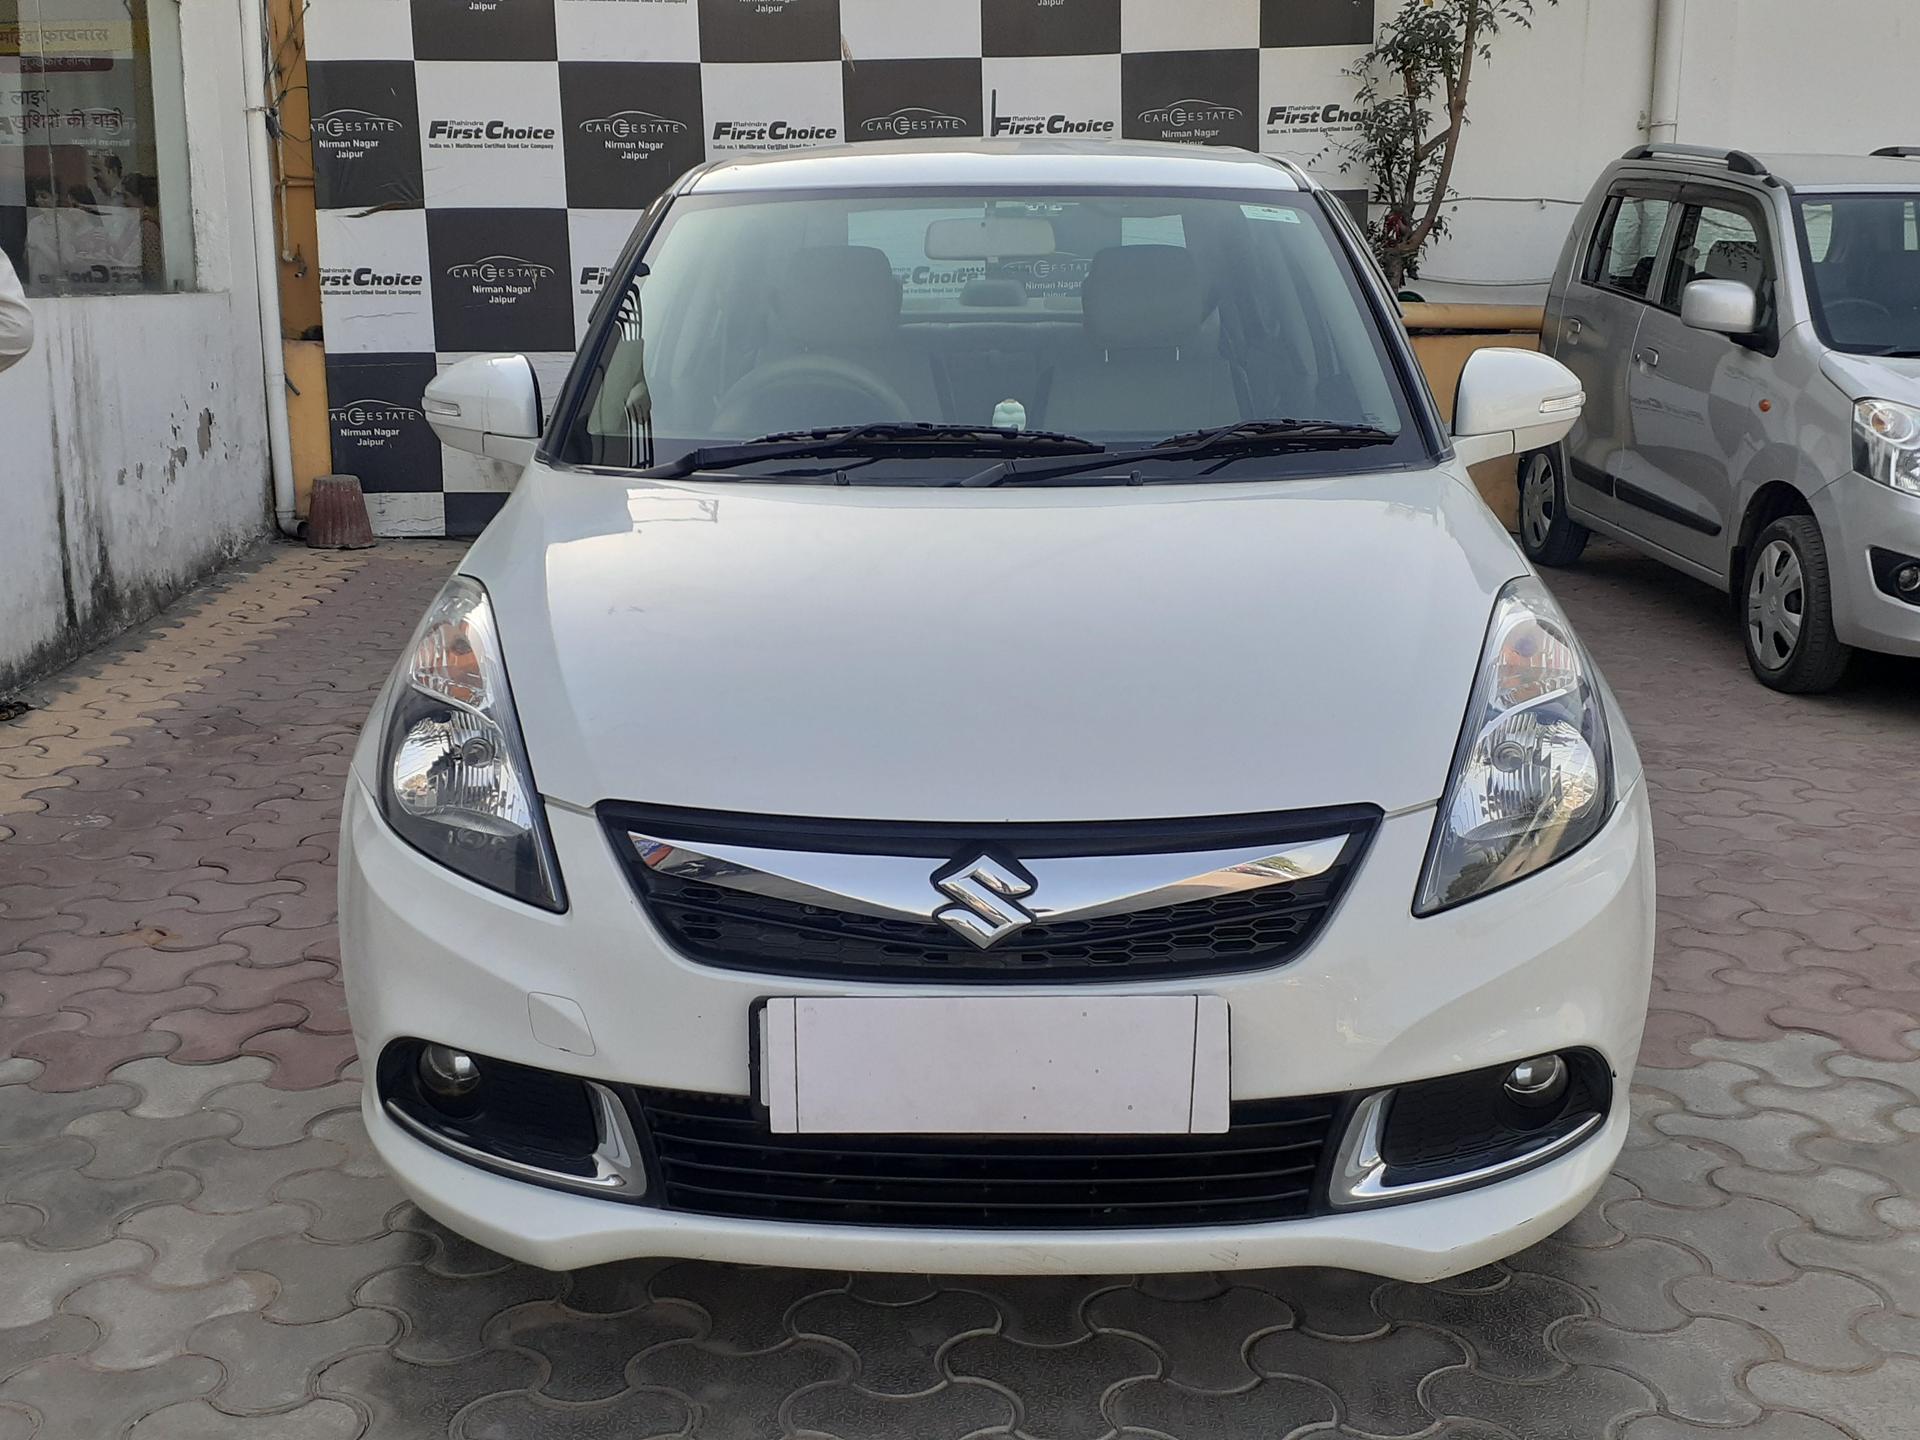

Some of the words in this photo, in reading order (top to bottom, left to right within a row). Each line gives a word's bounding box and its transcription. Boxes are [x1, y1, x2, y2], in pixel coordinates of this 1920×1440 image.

[468, 1, 497, 12] Jaipur
[755, 4, 783, 14] Jaipur
[63, 108, 86, 128] की
[1267, 106, 1320, 125] First
[310, 122, 325, 132] AR
[428, 120, 483, 139] First
[485, 120, 555, 139] Choice
[995, 117, 1045, 135] First
[1046, 115, 1114, 134] Choice
[712, 122, 767, 140] First
[768, 121, 837, 140] Choice
[1161, 129, 1192, 138] Nirman
[1194, 128, 1220, 138] Nagar
[319, 140, 351, 149] Nirman
[353, 139, 379, 149] Nagar
[604, 140, 636, 150] Nirman
[638, 140, 664, 151] Nagar
[336, 150, 364, 160] Jaipur
[621, 151, 649, 161] Jaipur
[320, 274, 351, 286] rst
[353, 267, 422, 286] Choice
[472, 285, 504, 293] Nirman
[506, 285, 531, 294] Nagar
[489, 295, 517, 305] Jaipur
[330, 412, 347, 421] AR
[340, 429, 372, 437] Nirman
[373, 428, 400, 437] Nagar
[357, 439, 385, 448] Jaipur
